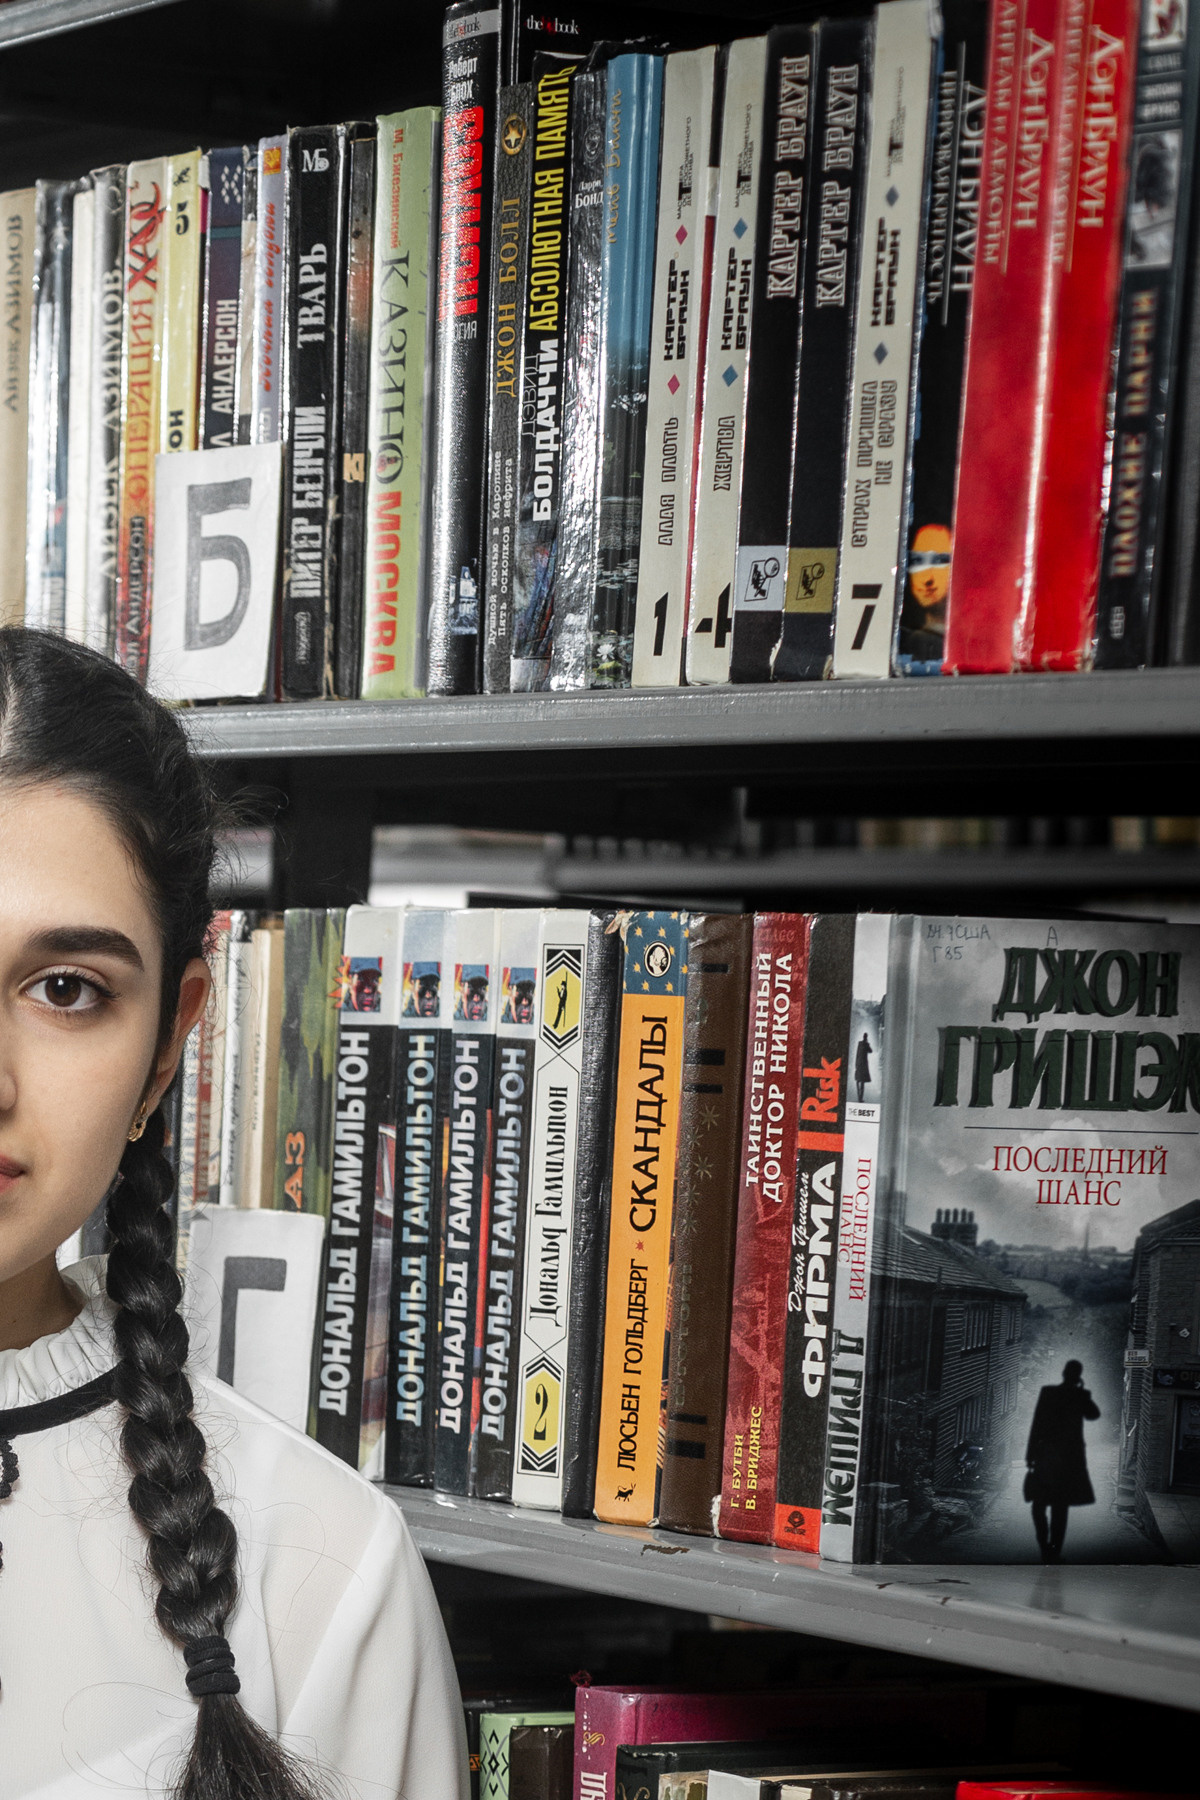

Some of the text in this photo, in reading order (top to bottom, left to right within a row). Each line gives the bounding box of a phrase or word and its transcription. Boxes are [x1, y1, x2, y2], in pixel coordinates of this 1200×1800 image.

[529, 65, 577, 331] АБСОЛЮТНАЯ ПАМЯТЬ
[575, 192, 604, 210] Бонд
[767, 54, 810, 299] КАРТЕР БРАУН
[815, 64, 859, 308] КАРТЕР БРАУН
[927, 70, 958, 304] ЦИФРОВАЯ КРЕПОСТЬ
[952, 80, 987, 291] ДЭН БРАУН
[297, 243, 327, 349] ТВАРЬ
[496, 197, 520, 397] ДЖОН БОЛЛ
[664, 259, 677, 361] КАРТЕР
[677, 270, 690, 360] БРАУН
[721, 247, 735, 350] КАРТЕР
[735, 259, 752, 350] БРАУН
[871, 217, 886, 327] КАРТЕР
[885, 229, 901, 326] БРАУН
[127, 299, 154, 501] ОПЕРАЦИЯ
[211, 299, 237, 414] АНДЕРСОН
[375, 250, 410, 484] КАЗИНО
[522, 353, 539, 437] ДЭВИД
[1124, 290, 1158, 420] ПАРНИ
[293, 406, 326, 510] БЕНЧЛИ
[532, 338, 560, 521] БОЛДАЧЧИ
[658, 416, 679, 546] АЛАЯ ПЛОТЬ
[713, 415, 735, 491] ЖЕРТВА
[851, 380, 878, 548] СТРАХ ПРИШЕЛ
[875, 379, 898, 486] НЕ СРАЗУ
[126, 515, 147, 633] АНДЕРСОН
[184, 477, 253, 652] Б
[290, 517, 323, 599] ПИТЕР
[368, 491, 402, 677] МОСКВА
[488, 450, 502, 645] Душной ночью Каролине
[497, 457, 513, 637] Пять осколков нефрита
[653, 592, 669, 656] 1
[694, 582, 732, 648] 4
[851, 584, 883, 650] 7
[769, 953, 793, 1073] НИКОЛА
[992, 946, 1182, 1025] ДЖОН
[629, 1015, 668, 1232] СКАНДАЛЫ
[746, 952, 772, 1187] ТАИНСТВЕННЫЙ
[858, 1108, 875, 1118] BEST
[530, 1086, 568, 1328] Дональд Гамильтон
[763, 1084, 785, 1202] ДОКТОР
[992, 1145, 1168, 1180] ПОСЛЕДНИЙ
[1036, 1179, 1122, 1207] ШАНС
[319, 1032, 370, 1417] ДОНАЛЬД ГАМИЛЬТОН
[396, 1035, 435, 1427] ДОНАЛЬД ГАМИЛЬТОН
[440, 1040, 480, 1434] ДОНАЛЬД ГАМИЛЬТОН
[481, 1048, 526, 1442] ДОНАЛЬД ГАМИЛЬТОН
[787, 1171, 810, 1313] Джон Гришем
[801, 1160, 837, 1399] ФИРМА
[837, 1194, 854, 1264] ШАНС
[848, 1157, 872, 1302] ПОСЛЕДНИЙ
[217, 1256, 288, 1390] Г
[617, 1259, 648, 1471] ЛЮСЬЕН ГОЛЬДБЕРГ
[533, 1383, 549, 1441] 2
[730, 1433, 745, 1508] Г. БУТБИ
[745, 1406, 763, 1510] В. БРИДЖЕС
[822, 1367, 864, 1527] ГРИШЭМ
